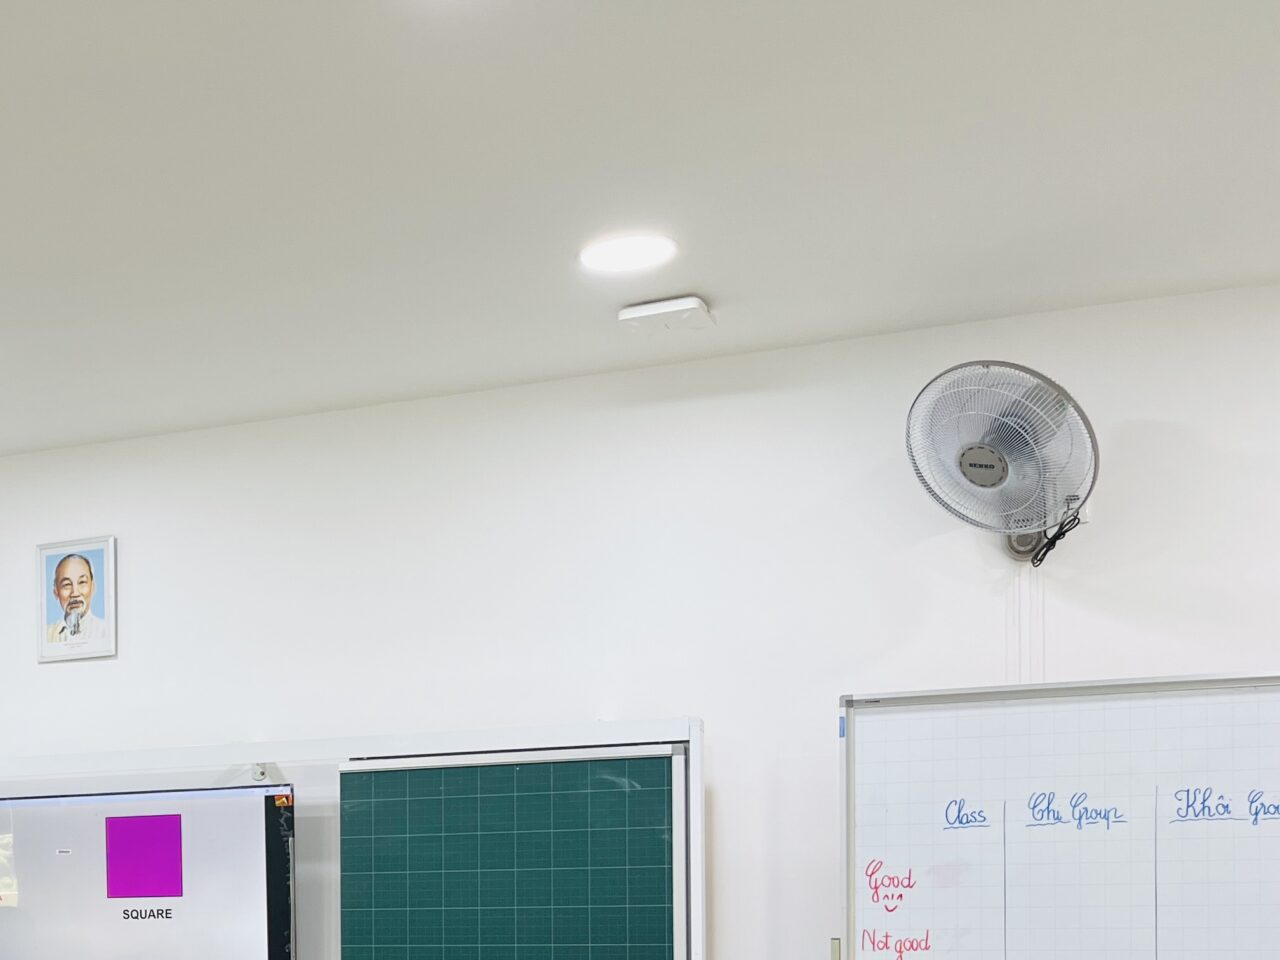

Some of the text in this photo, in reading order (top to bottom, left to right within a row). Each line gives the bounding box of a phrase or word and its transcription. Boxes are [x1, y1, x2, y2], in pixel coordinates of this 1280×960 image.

[944, 798, 987, 825] Class
[1069, 791, 1125, 830] Group
[1174, 787, 1232, 818] Khôi
[865, 859, 917, 902] Good
[122, 908, 173, 920] SQUARE
[861, 929, 891, 952] Not
